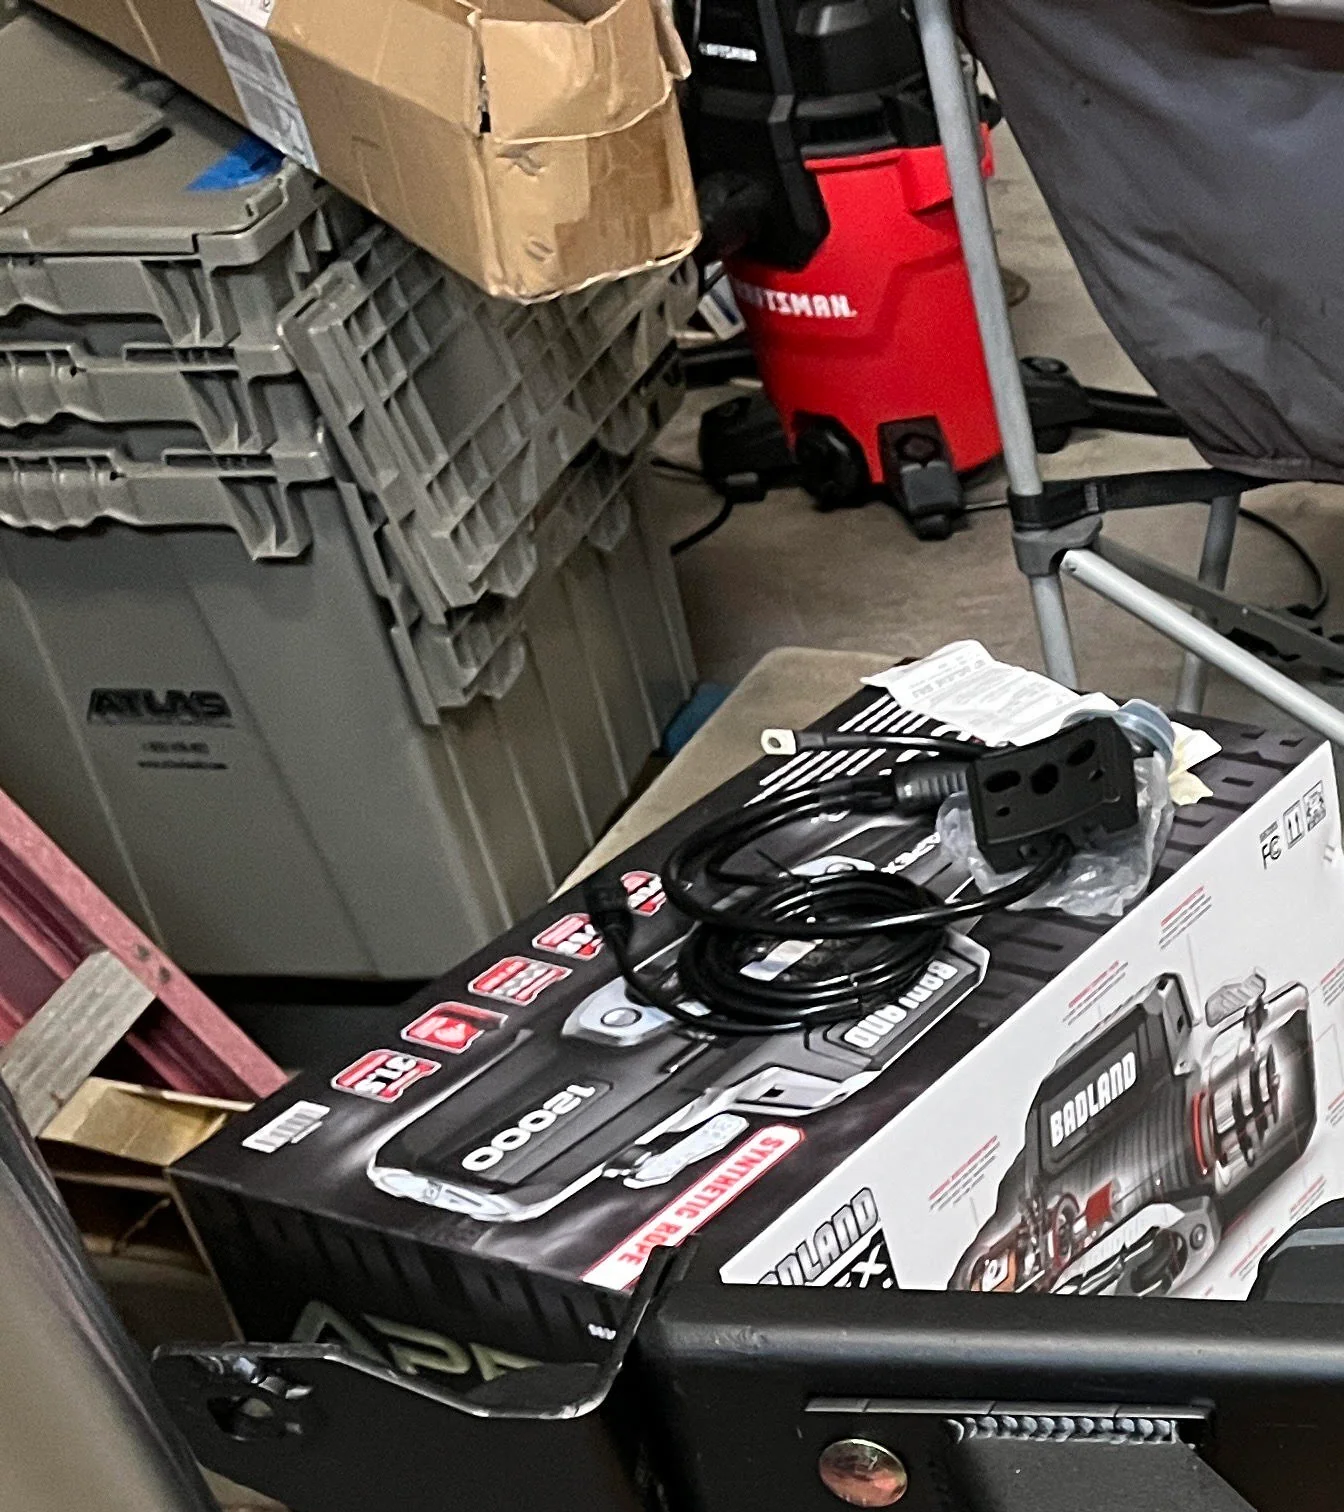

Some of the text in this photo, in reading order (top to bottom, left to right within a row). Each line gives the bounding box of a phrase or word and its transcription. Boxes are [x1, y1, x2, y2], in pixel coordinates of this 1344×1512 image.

[461, 1083, 596, 1172] 12000
[1050, 1051, 1137, 1148] BADLAND
[616, 1135, 785, 1266] SYNTHETIC ROPE
[758, 1187, 880, 1286] DLAND
